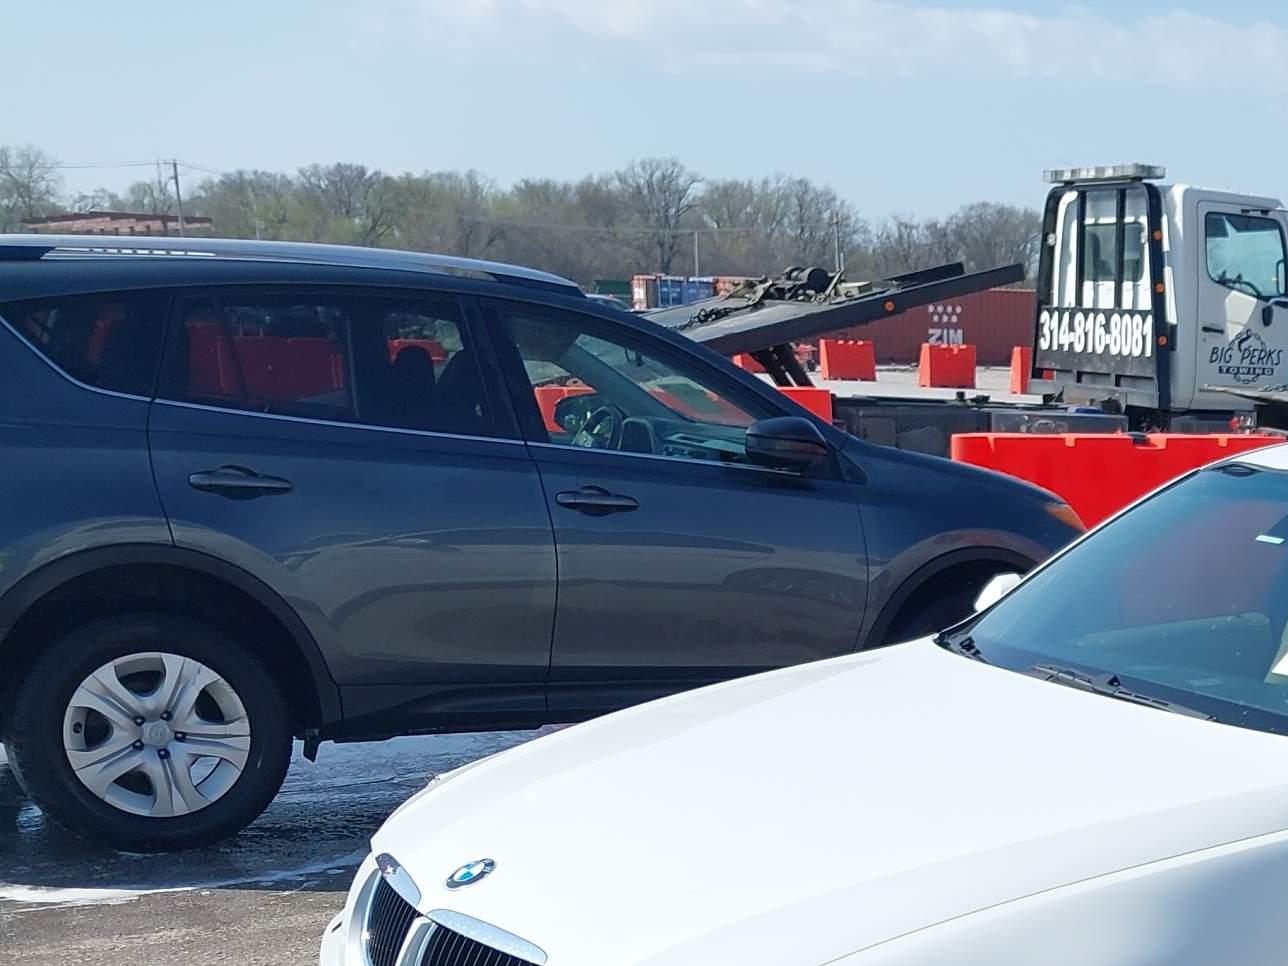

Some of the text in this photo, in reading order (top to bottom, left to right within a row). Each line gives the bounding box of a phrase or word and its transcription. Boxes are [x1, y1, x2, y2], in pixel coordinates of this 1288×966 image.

[927, 328, 964, 345] ZIM
[1039, 310, 1153, 357] 314-816-8081
[1209, 346, 1284, 366] BIG PERKS
[1218, 366, 1275, 375] TOWING
